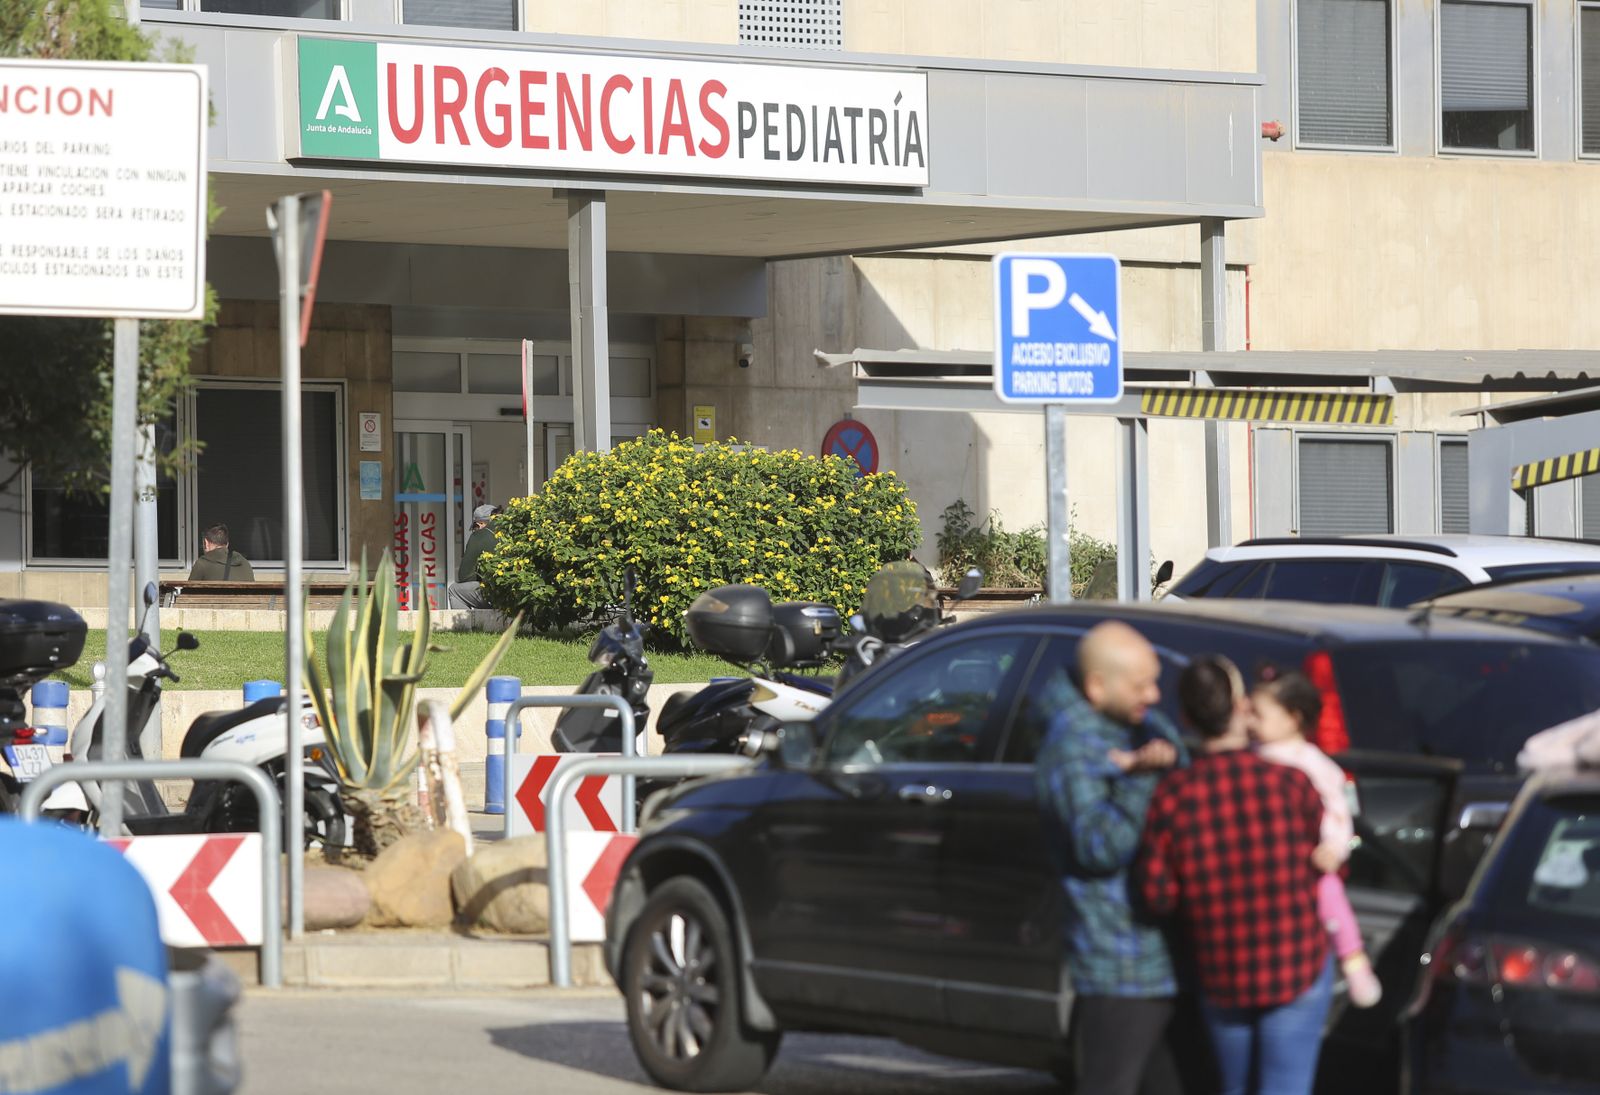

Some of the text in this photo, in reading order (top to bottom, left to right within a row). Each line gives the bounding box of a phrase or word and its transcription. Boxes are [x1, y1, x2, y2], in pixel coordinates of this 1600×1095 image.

[387, 62, 925, 168] URGENCIAS PEDIATRÍA
[306, 123, 372, 135] Junta de Andalucía
[36, 141, 55, 154] DEL
[63, 142, 111, 156] PARKING
[38, 166, 108, 179] VINCULACION
[116, 168, 139, 180] CON
[3, 181, 104, 196] APARCAR COCHES
[11, 203, 87, 218] ESTACIONADO
[96, 206, 123, 220] SERA
[132, 208, 185, 222] RETIRADO
[12, 244, 88, 259] RESPONSABLE
[97, 246, 109, 260] DE
[118, 248, 138, 260] LOS
[45, 262, 128, 278] ESTACIONADOS
[136, 264, 151, 278] EN
[157, 265, 183, 279] ESTE
[1011, 258, 1067, 338] P
[1011, 342, 1110, 367] ACCESO EXCLUSIVO
[1012, 371, 1094, 395] PARKING MOTOS
